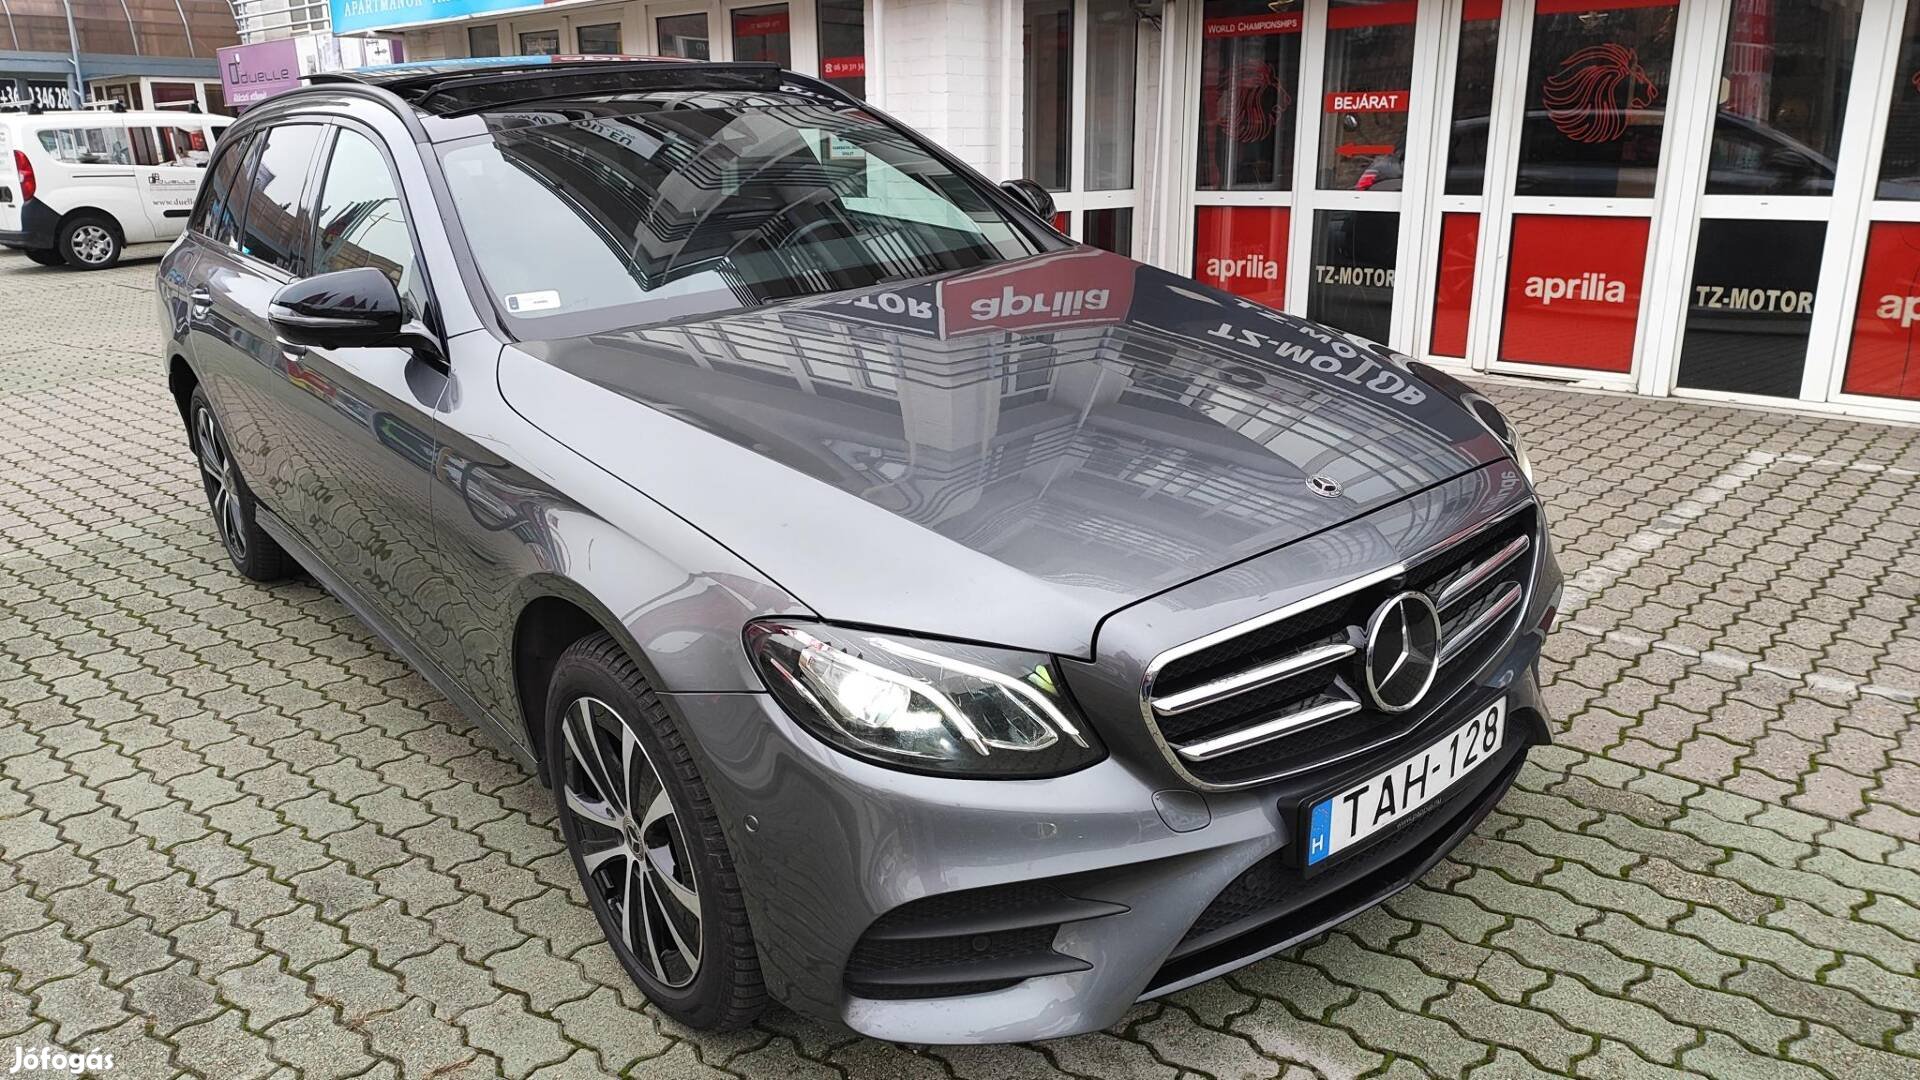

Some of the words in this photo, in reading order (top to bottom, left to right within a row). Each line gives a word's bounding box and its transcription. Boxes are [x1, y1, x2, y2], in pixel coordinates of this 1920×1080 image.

[1208, 24, 1235, 33] WORLD
[1237, 19, 1298, 31] CHAMPIONSHIPS
[1334, 93, 1399, 110] BEJÁRAT
[1206, 254, 1278, 282] aprilia
[1316, 265, 1395, 287] TZ-MOTOR
[1525, 272, 1626, 305] aprilia
[1696, 286, 1814, 314] TZ-MOTOR
[1343, 705, 1499, 838] TAH-128
[1311, 834, 1324, 855] H
